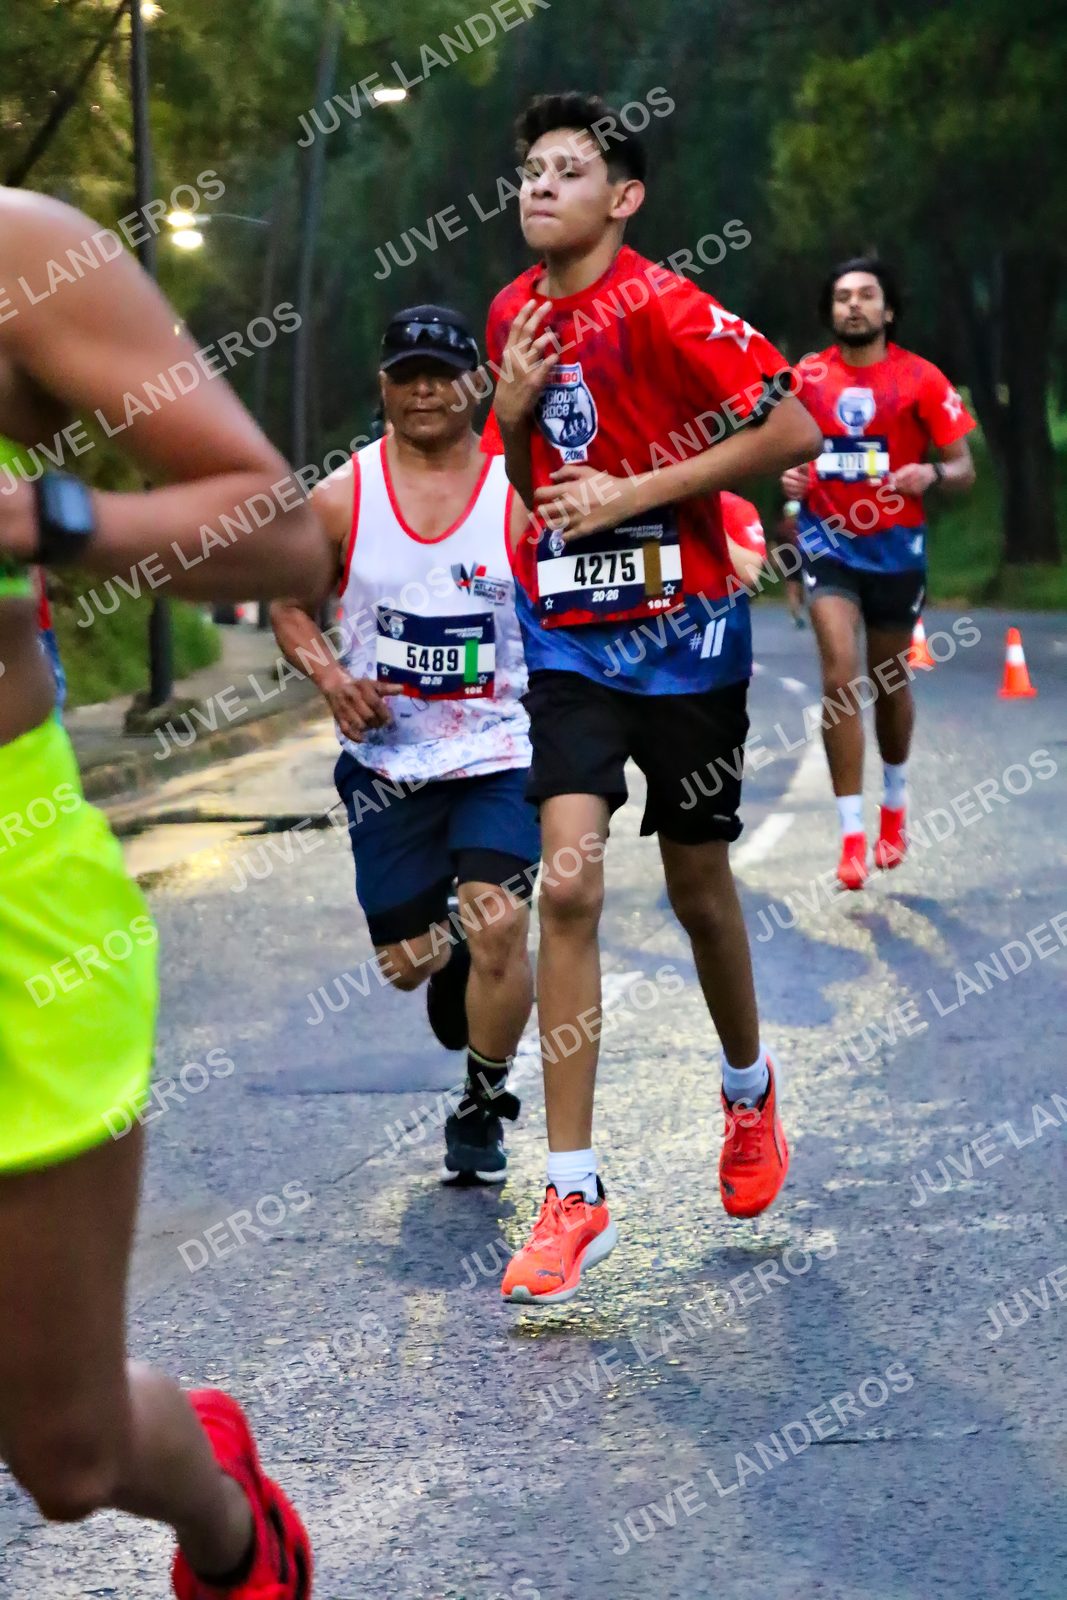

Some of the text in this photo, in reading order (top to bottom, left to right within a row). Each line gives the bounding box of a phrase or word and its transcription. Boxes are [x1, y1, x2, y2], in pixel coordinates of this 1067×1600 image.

[574, 552, 636, 586] 4275
[647, 598, 671, 609] 10K
[406, 645, 459, 672] 5489
